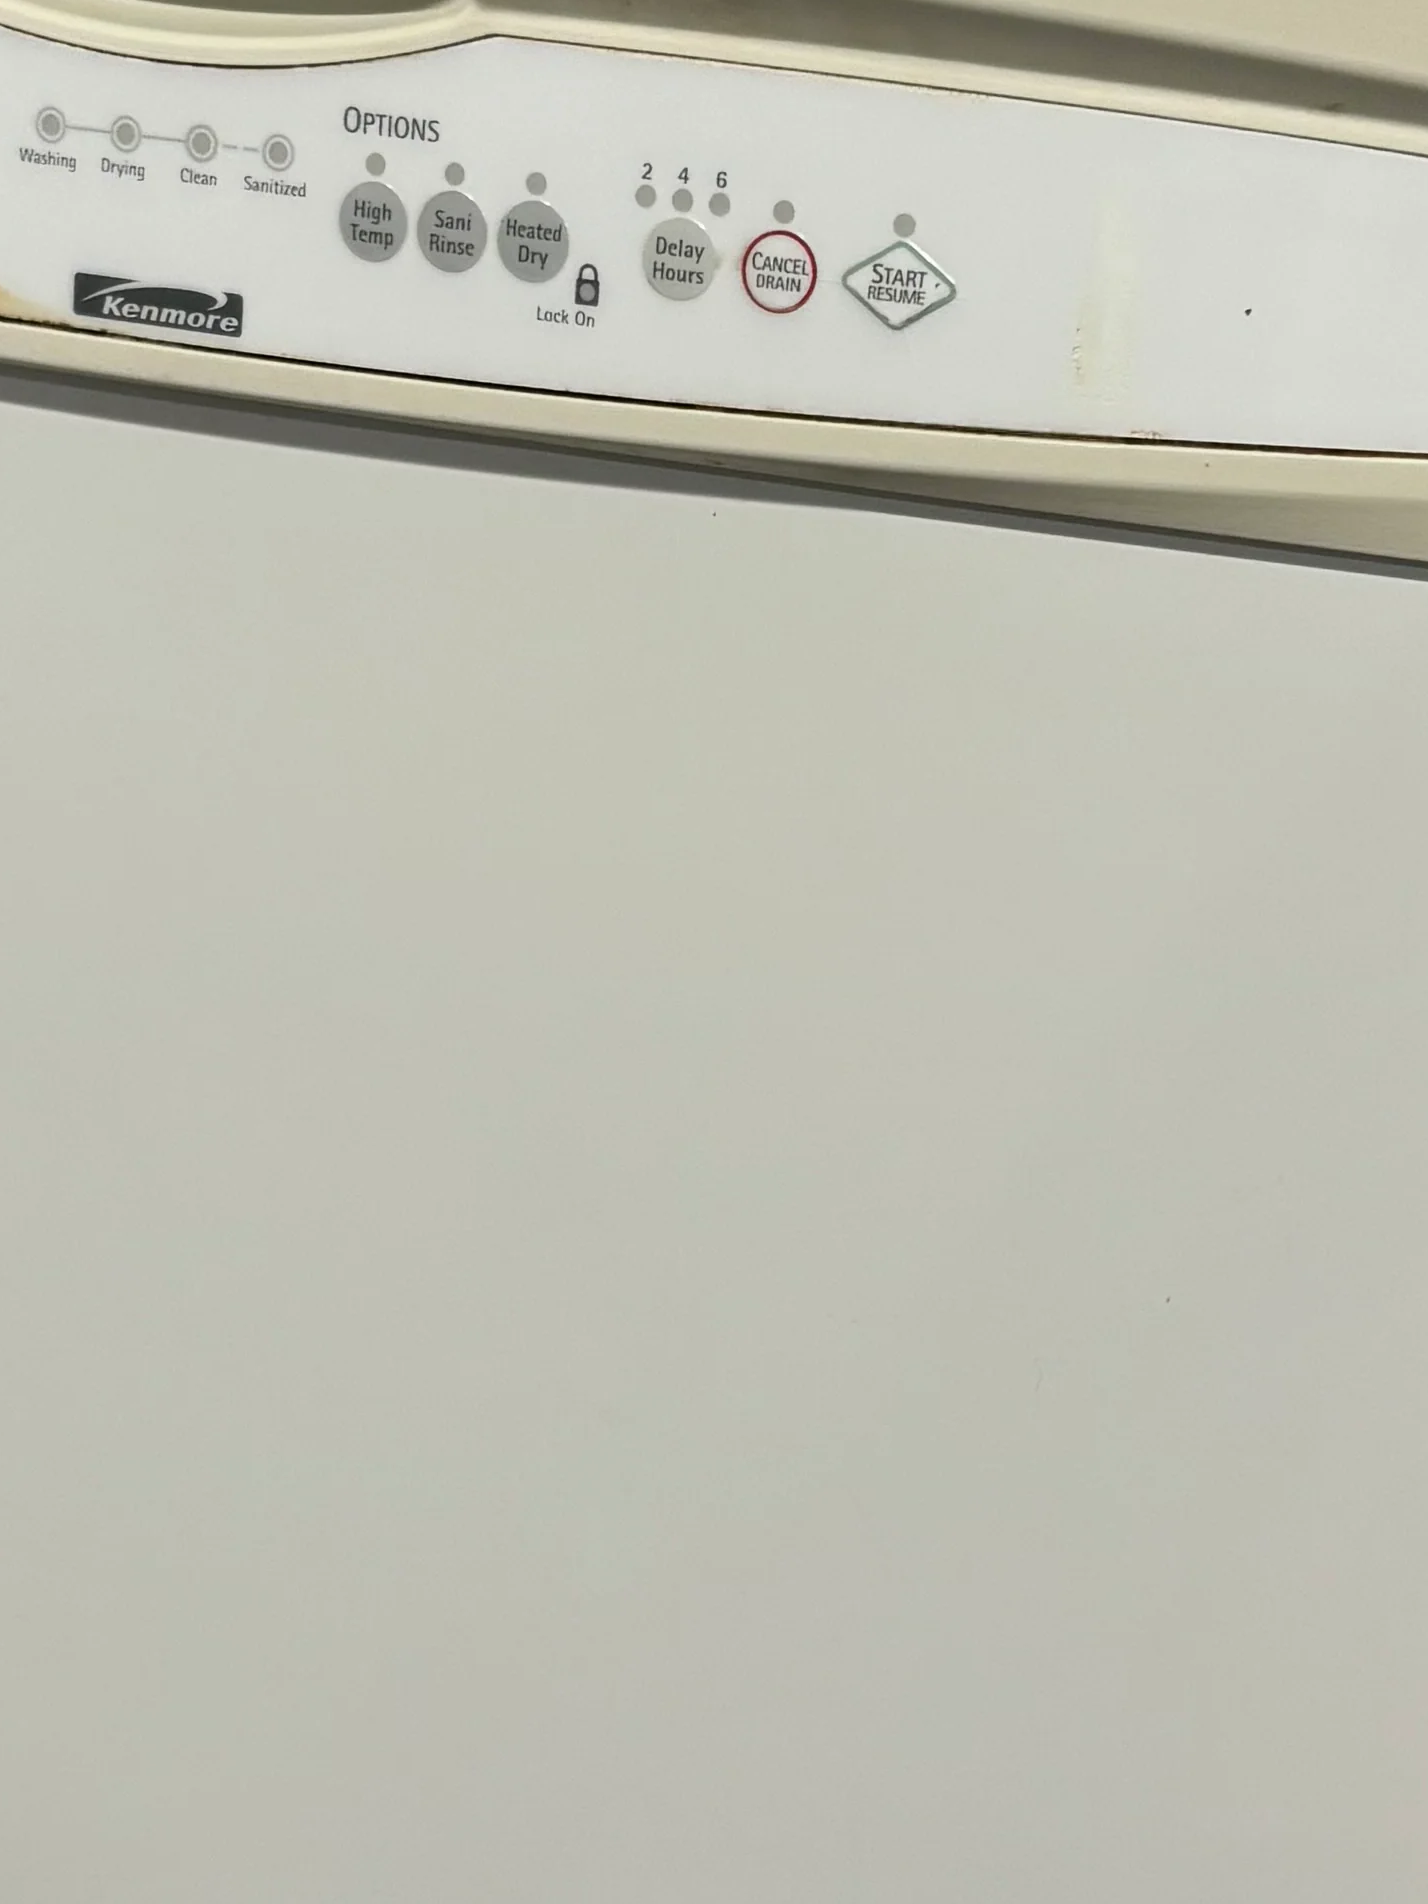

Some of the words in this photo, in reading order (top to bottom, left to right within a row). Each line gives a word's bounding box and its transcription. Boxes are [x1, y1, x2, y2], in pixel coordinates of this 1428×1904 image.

[18, 148, 77, 172] Washing
[101, 157, 145, 181] Drying
[180, 167, 217, 187] Clean
[243, 176, 307, 198] Sanitized
[641, 162, 654, 181] 2
[677, 167, 690, 185] 4
[715, 171, 728, 190] 6
[353, 199, 392, 223] High
[433, 209, 472, 233] Sani
[349, 224, 394, 250] Temp
[506, 218, 563, 244] Heated
[428, 233, 476, 258] Rinse
[517, 244, 549, 270] Dry
[654, 235, 706, 265] Delay
[652, 260, 705, 285] Hours
[756, 273, 803, 294] DRAIN
[867, 285, 926, 307] RESUME
[102, 295, 239, 333] Kenmore
[536, 306, 570, 325] Lock
[574, 310, 596, 328] On
